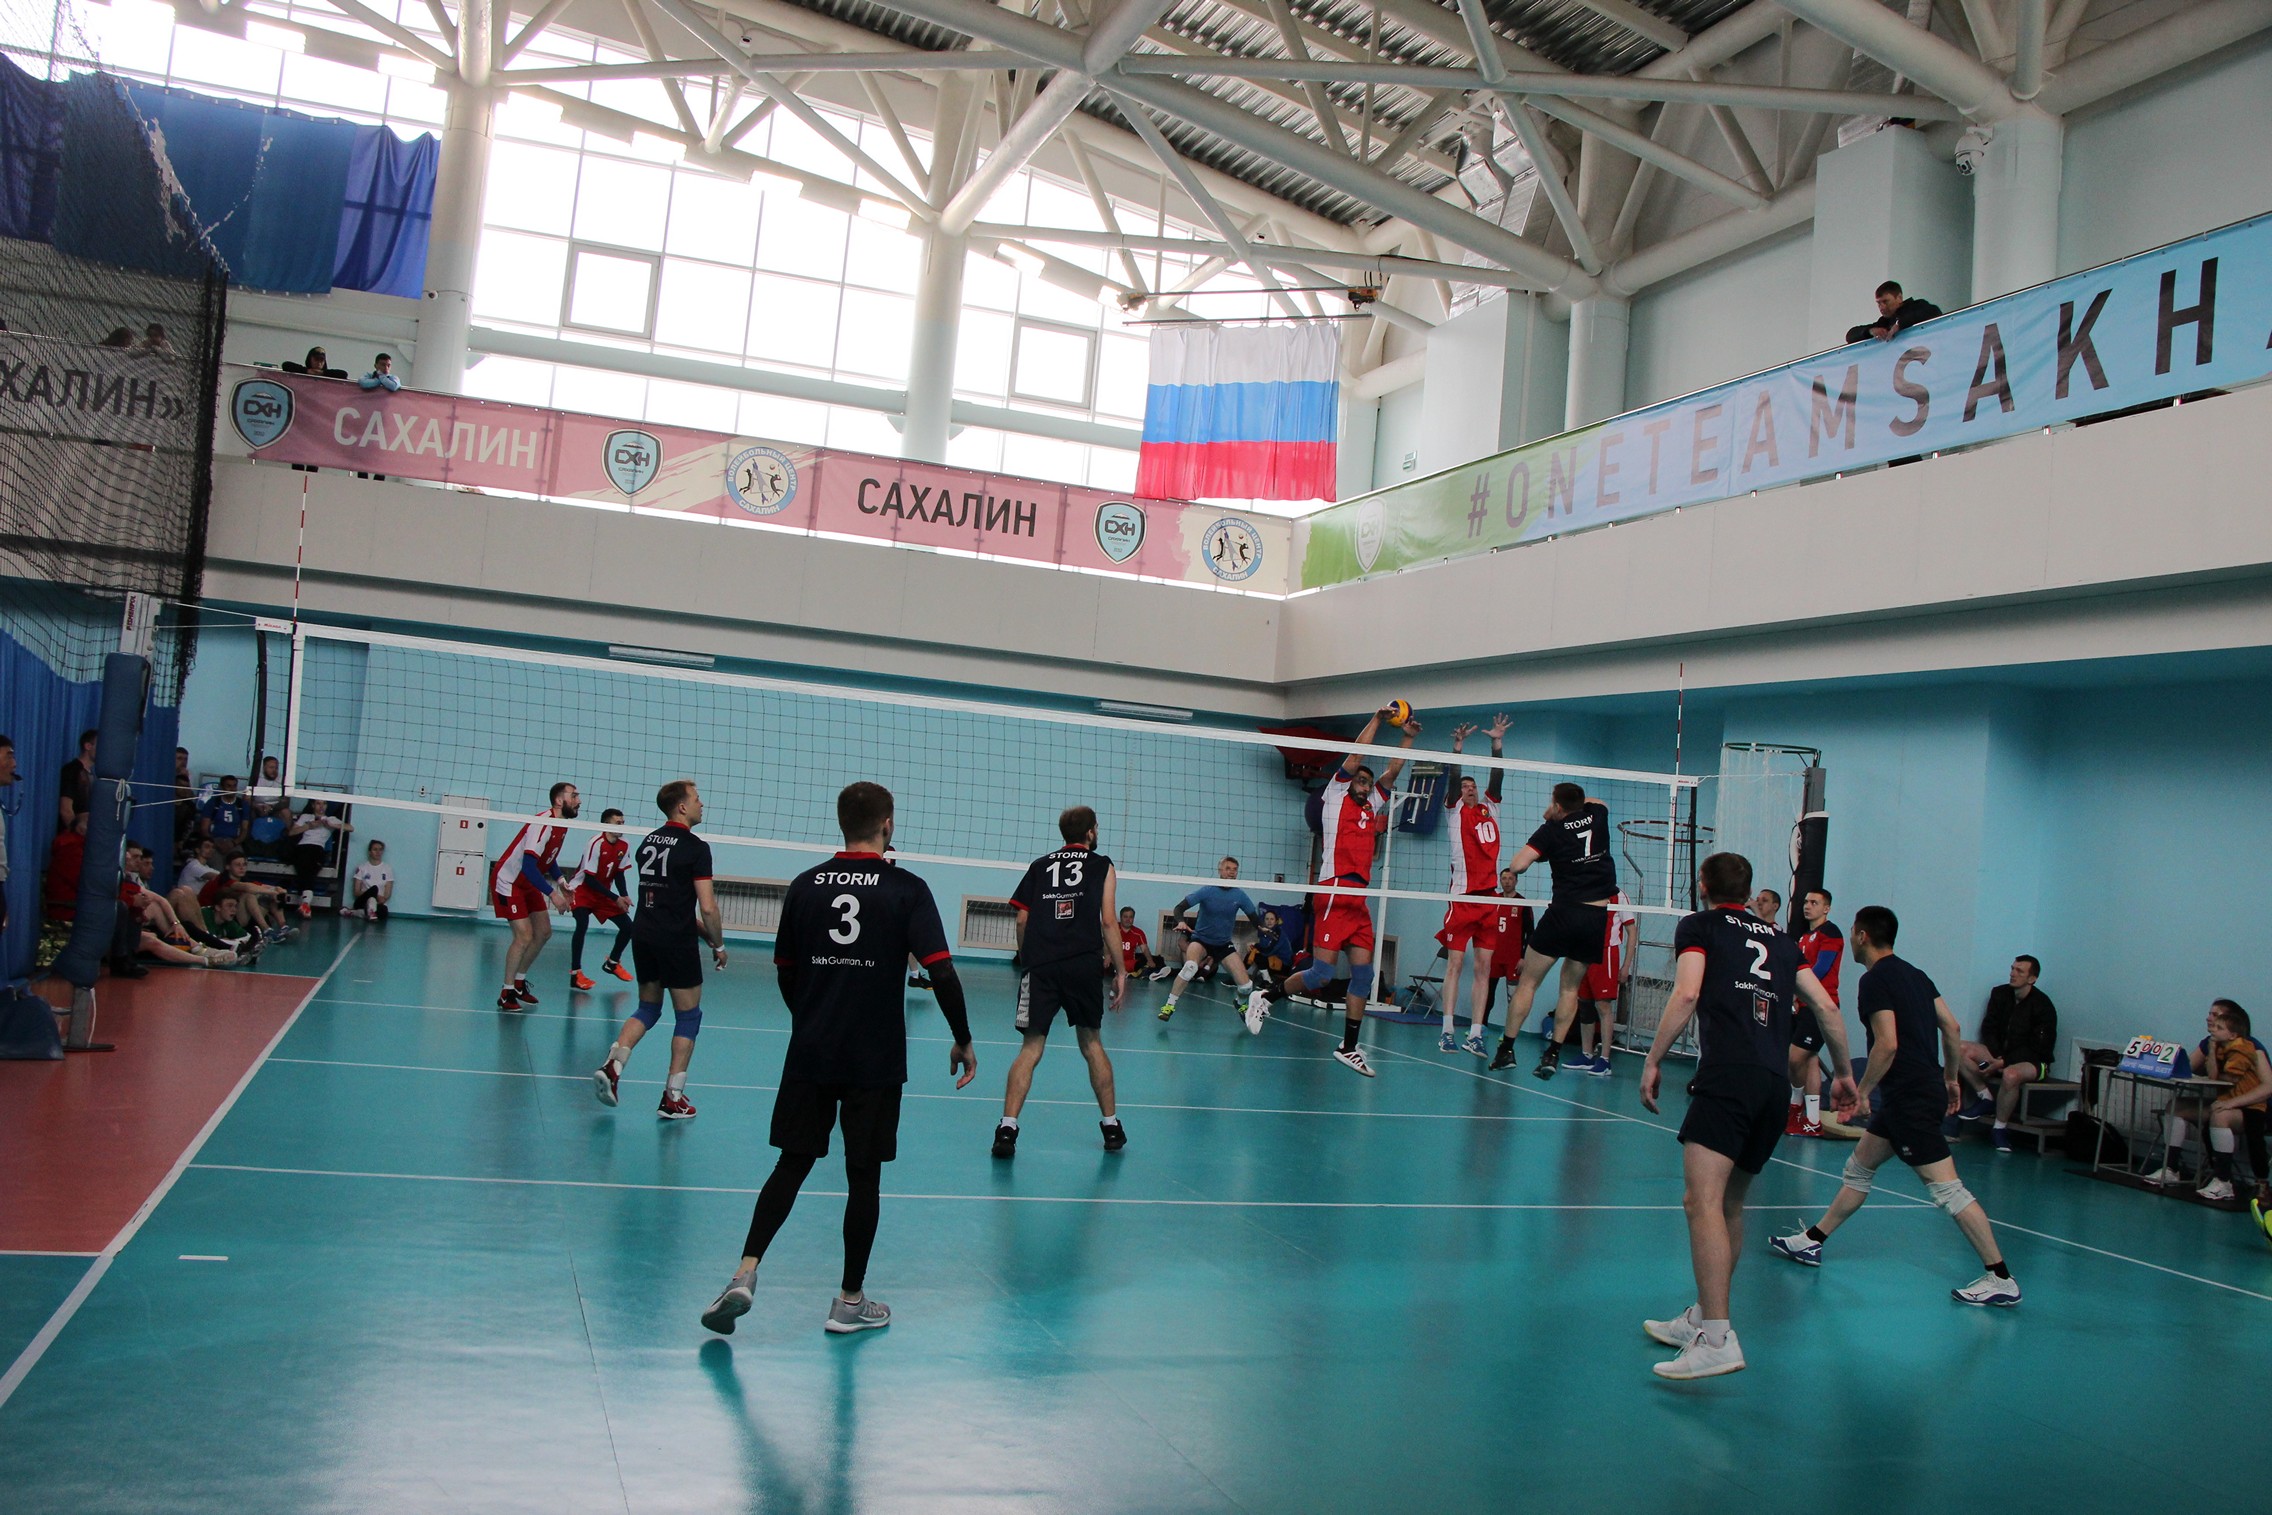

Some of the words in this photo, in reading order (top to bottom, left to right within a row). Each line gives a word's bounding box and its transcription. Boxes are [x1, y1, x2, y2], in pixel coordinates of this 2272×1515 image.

[1467, 256, 2272, 539] #ONETEAMSAKH
[333, 407, 538, 470] САХАЛИН
[728, 448, 786, 482] ВОЛЕЙБОЛЬНЫЙ
[785, 462, 797, 491] ЦЕНТР
[738, 499, 780, 515] САХАЛИН
[857, 478, 1037, 537] САХАЛИН
[1212, 566, 1248, 581] САХАЛИН
[223, 810, 234, 823] 5
[646, 834, 679, 847] STORM
[1474, 821, 1497, 844] 10
[1576, 829, 1593, 857] 7
[545, 846, 559, 865] 3
[640, 845, 671, 877] 21
[1048, 851, 1088, 859] STORM
[606, 861, 615, 878] 1
[813, 871, 880, 886] STORM
[1045, 860, 1083, 888] 13
[828, 893, 861, 945] 3
[1498, 916, 1507, 933] 5
[1745, 938, 1772, 981] 2
[2127, 1041, 2141, 1055] 5
[2160, 1046, 2174, 1062] 2
